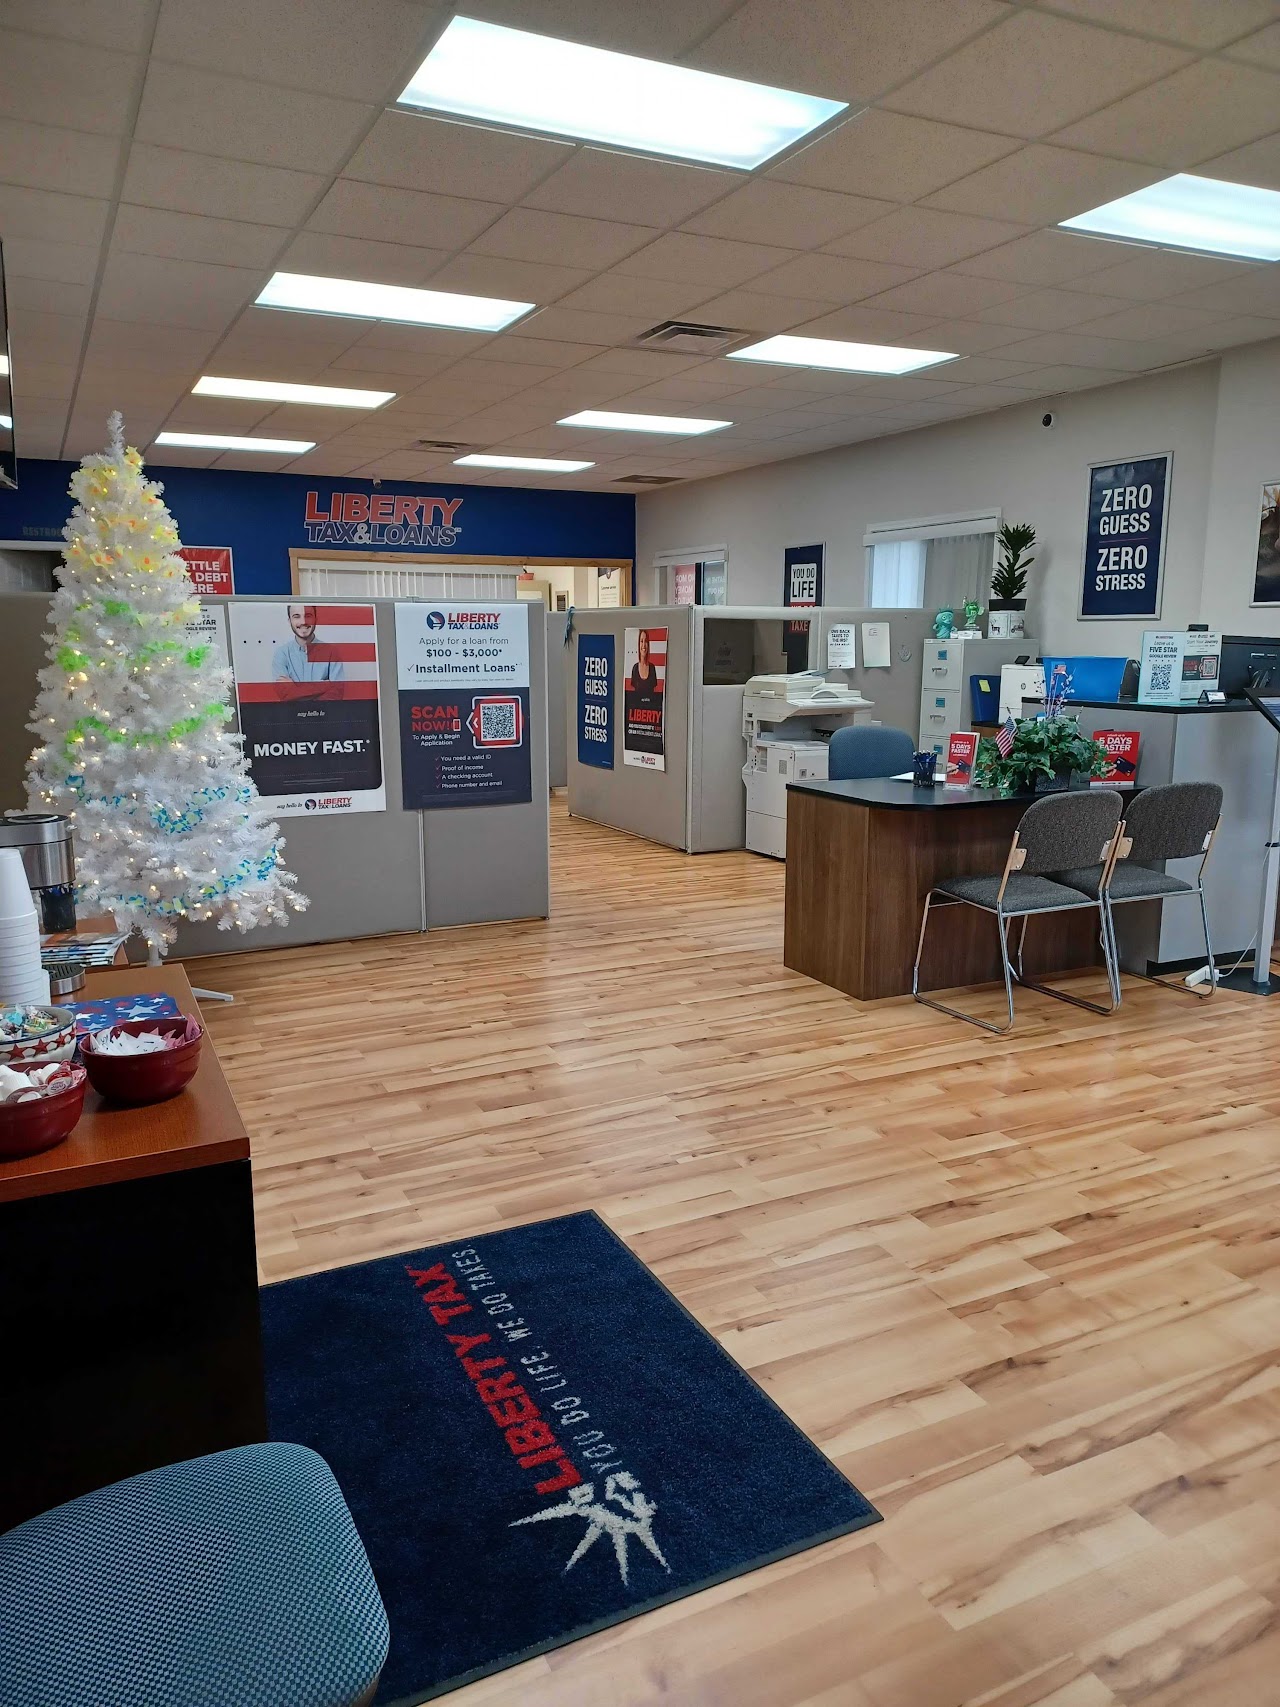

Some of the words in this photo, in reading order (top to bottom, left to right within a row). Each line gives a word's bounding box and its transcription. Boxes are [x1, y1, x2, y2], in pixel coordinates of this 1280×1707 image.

[1100, 483, 1153, 513] ZERO
[305, 491, 464, 526] LIBERTY
[1099, 512, 1151, 536] GUESS
[185, 560, 220, 571] ETTLE
[1096, 544, 1148, 572] ZERO
[195, 572, 228, 582] DEBT
[792, 568, 805, 578] YOU
[806, 567, 815, 578] DO
[791, 580, 815, 598] LIFE
[1095, 572, 1146, 591] STRESS
[447, 612, 501, 623] LIBERTY
[790, 620, 808, 631] TAXE
[419, 637, 445, 646] Apply
[447, 637, 459, 645] for
[469, 637, 487, 645] loan
[489, 637, 509, 645] from
[426, 648, 452, 658] $100
[415, 663, 480, 674] Installment
[584, 657, 608, 677] ZERO
[584, 678, 608, 696] GUESS
[411, 705, 459, 719] SCAN
[584, 705, 608, 726] ZERO
[628, 709, 662, 724] LIBERTY
[411, 720, 450, 732] NOW!
[584, 726, 608, 743] STRESS
[253, 741, 319, 757] MONEY
[1107, 737, 1133, 745] DAYS
[447, 773, 471, 781] checking
[318, 796, 353, 805] LIBERTY
[406, 1262, 474, 1326] TAX
[481, 1292, 515, 1316] DO
[496, 1317, 533, 1342] WE
[444, 1332, 582, 1496] LIBERTY
[550, 1396, 590, 1426] DO
[573, 1430, 623, 1474] YOU
